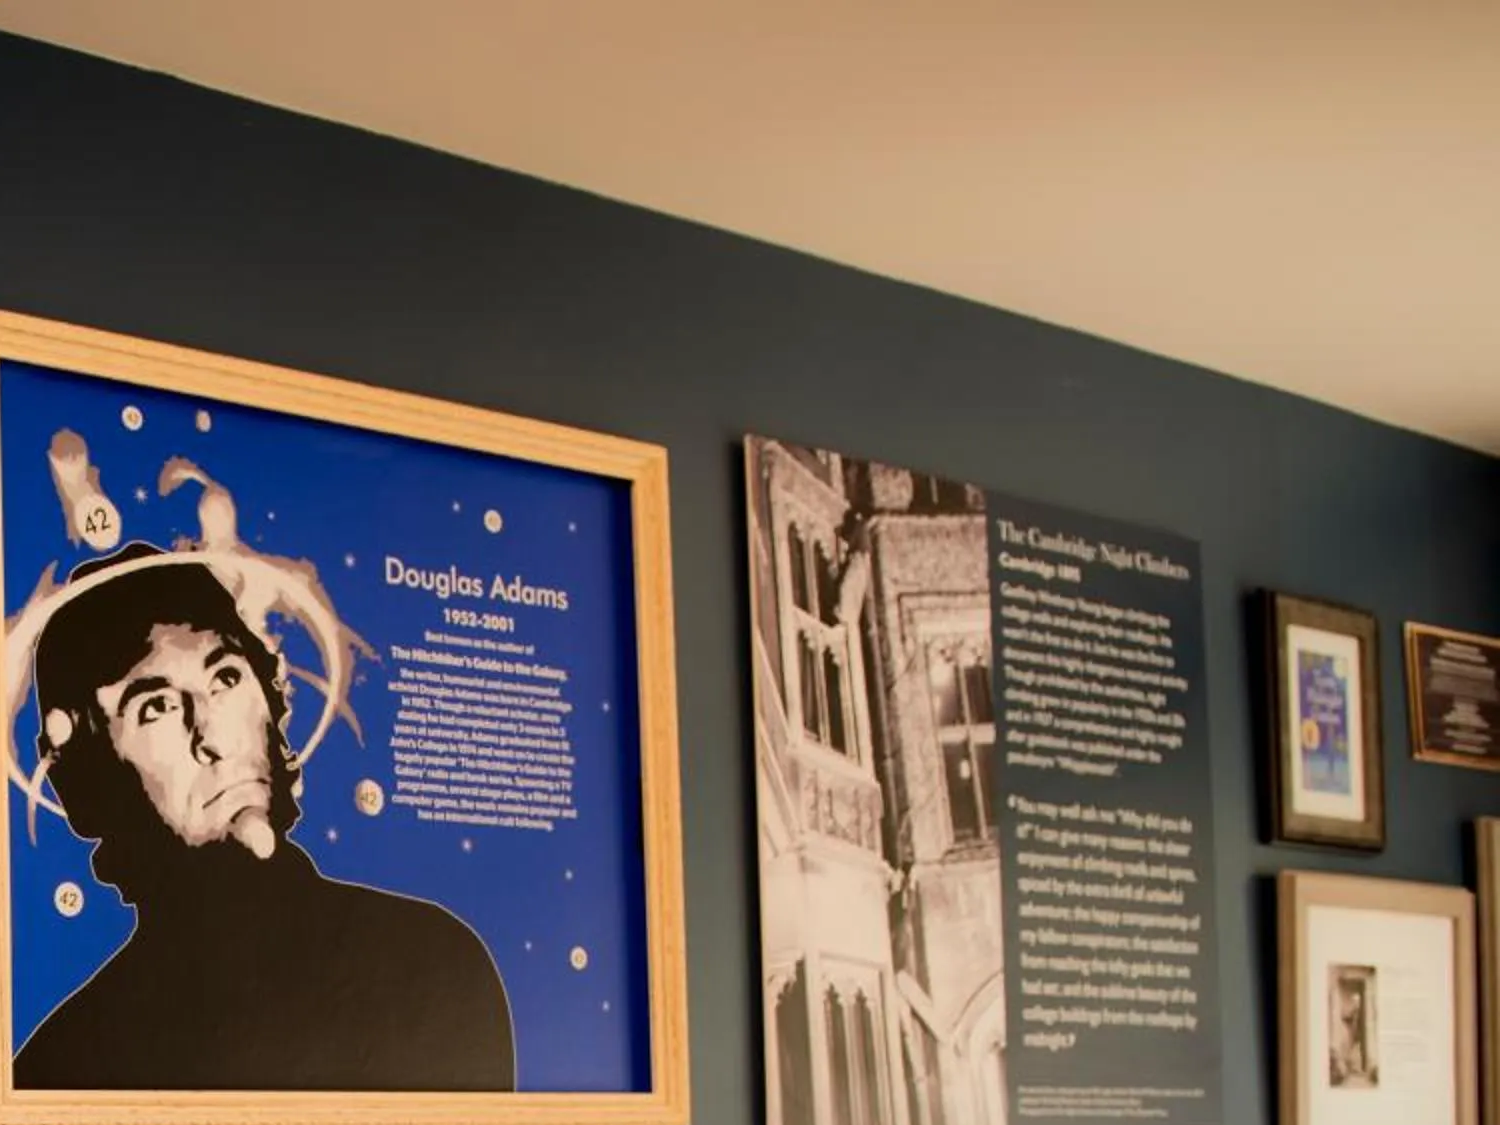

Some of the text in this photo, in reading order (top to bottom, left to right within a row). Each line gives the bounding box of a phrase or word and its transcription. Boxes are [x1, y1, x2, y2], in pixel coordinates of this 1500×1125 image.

[85, 508, 111, 535] 42
[996, 518, 1027, 546] The
[1028, 526, 1098, 563] Cambridge
[385, 556, 569, 611] Douglas Adams
[443, 607, 515, 633] 1952-2001
[60, 891, 77, 908] 42
